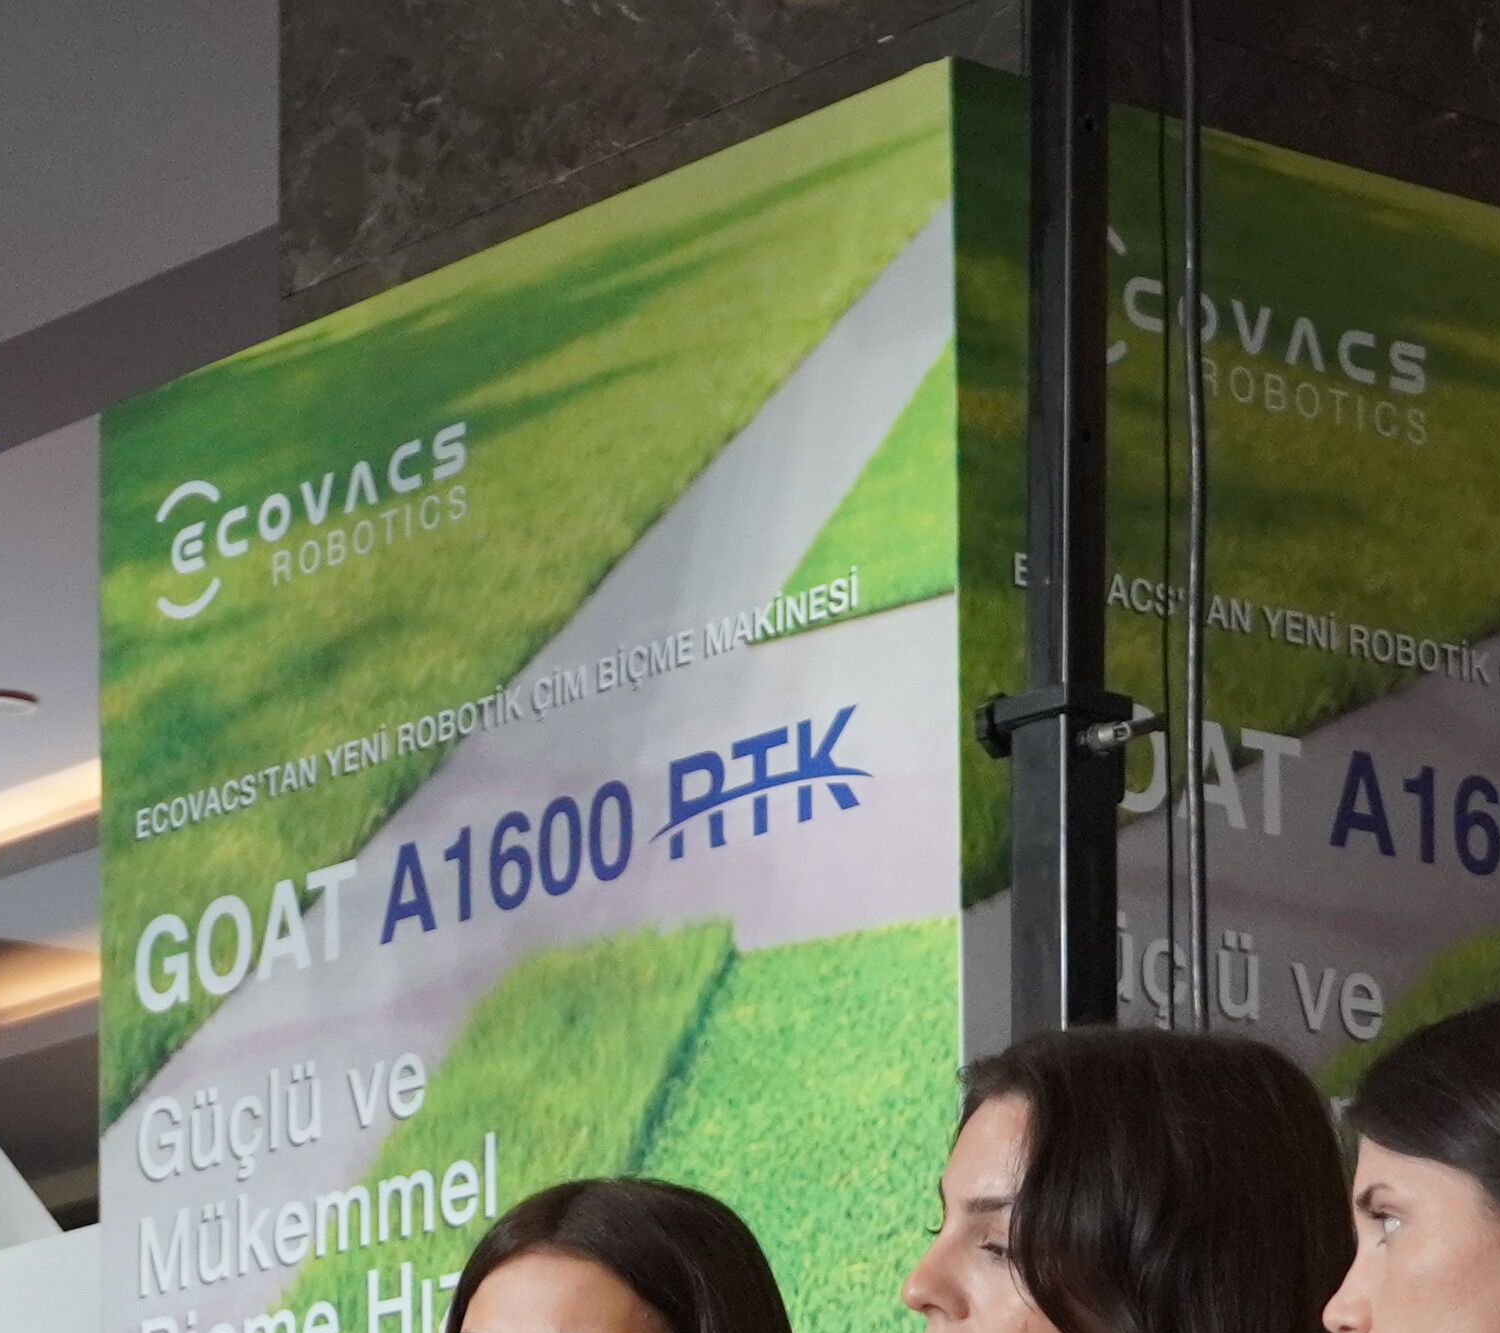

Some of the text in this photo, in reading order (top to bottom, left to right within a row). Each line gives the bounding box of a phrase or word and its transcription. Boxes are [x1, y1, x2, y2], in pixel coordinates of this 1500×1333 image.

[1123, 276, 1427, 394] COVACS
[170, 421, 468, 575] ECOVACS
[272, 486, 469, 588] ROBOTICS
[134, 565, 861, 840] ECOVACS'TAN YENİ ROBOTİK ÇİM BİÇME MAKİNESİ
[1263, 606, 1338, 651] YENİ
[1350, 623, 1490, 687] ROBOTİK
[1118, 704, 1302, 836] OAT
[134, 704, 874, 1014] GOAT A1600 RTK
[1291, 962, 1384, 1039] ve
[137, 1051, 427, 1182] Güçlü ve
[137, 1131, 498, 1299] Mükemmel
